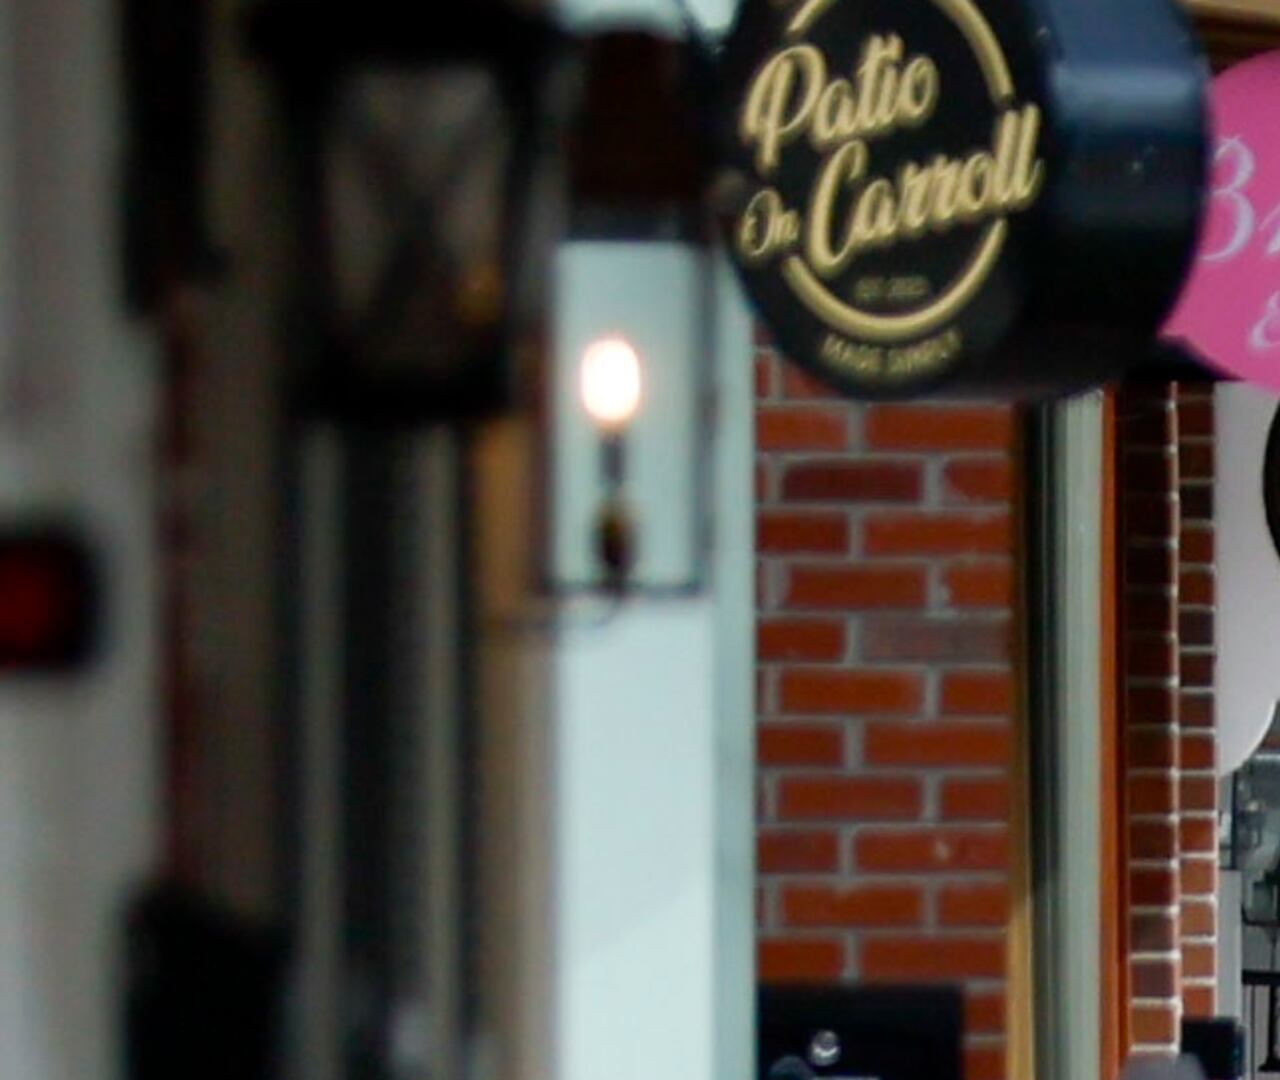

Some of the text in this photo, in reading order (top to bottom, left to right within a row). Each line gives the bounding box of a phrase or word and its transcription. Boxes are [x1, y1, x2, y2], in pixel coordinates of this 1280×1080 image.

[741, 33, 938, 170] Patio
[740, 103, 1046, 274] On Carroll
